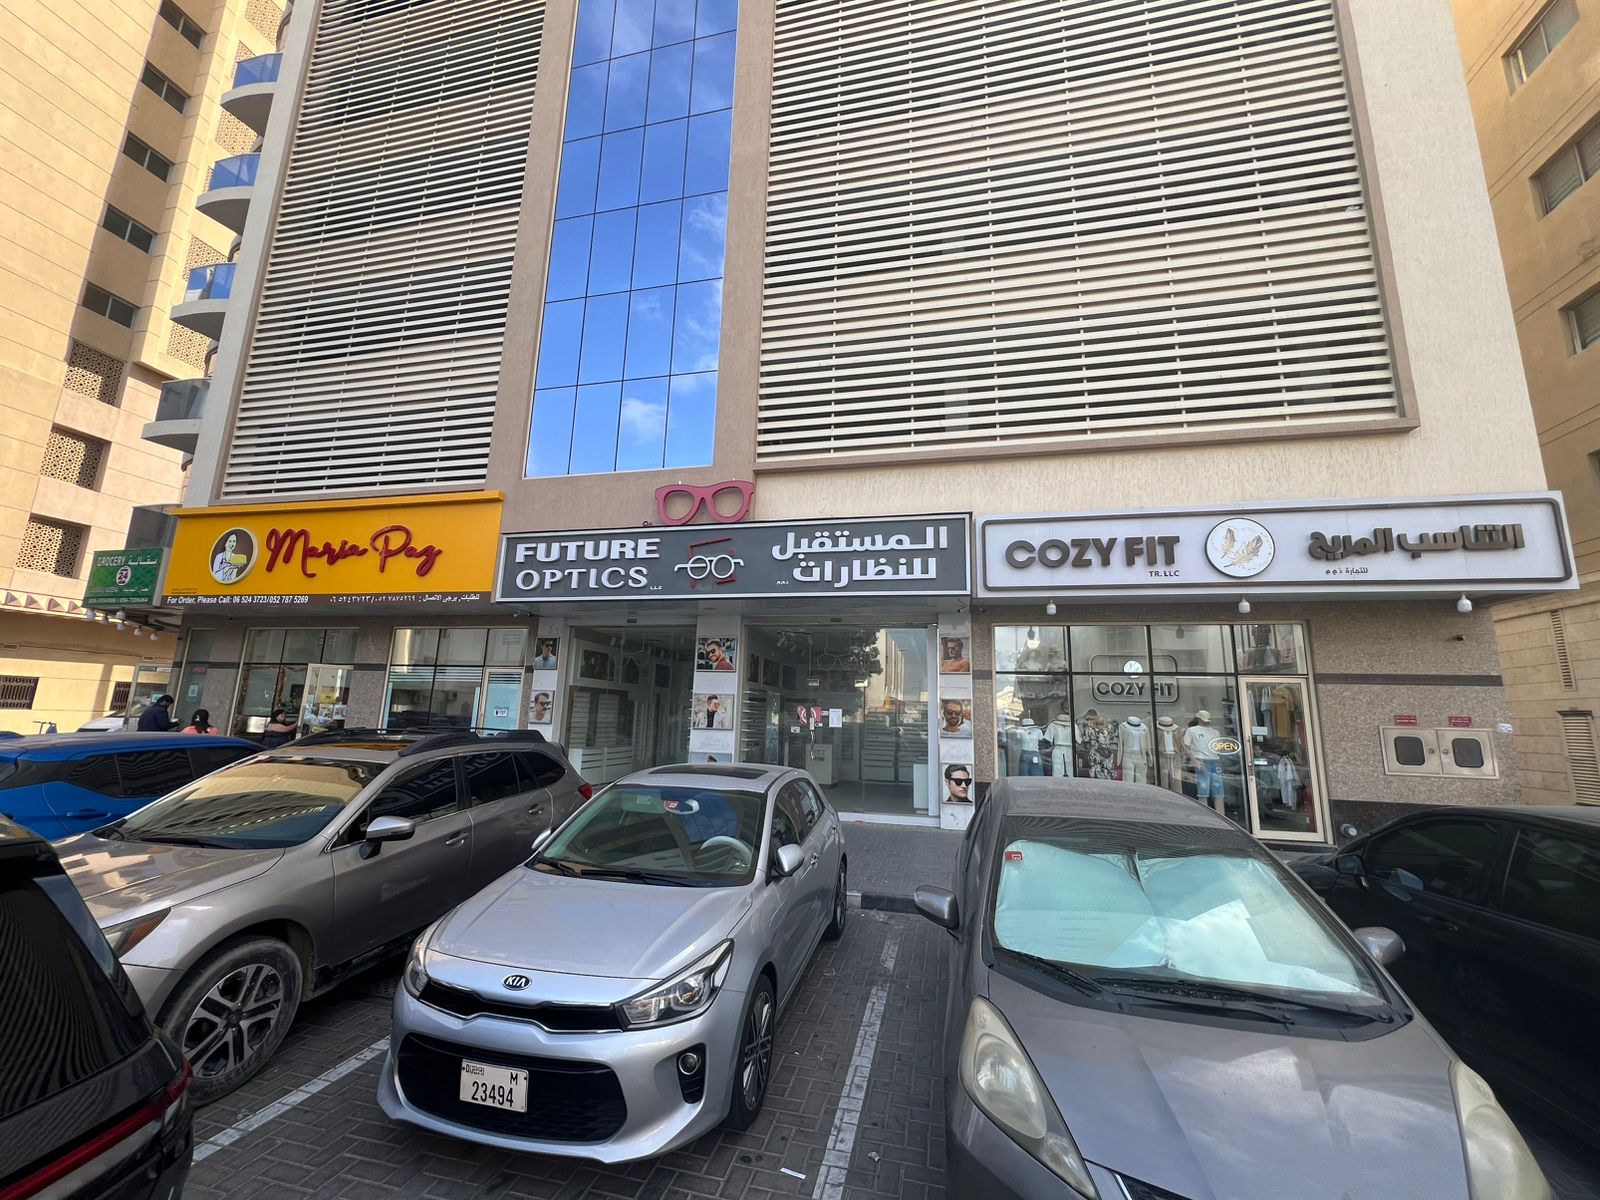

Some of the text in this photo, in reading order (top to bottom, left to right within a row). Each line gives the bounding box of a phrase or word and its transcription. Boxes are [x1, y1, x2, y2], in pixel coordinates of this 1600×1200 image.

[266, 525, 443, 578] Maria Paz
[515, 538, 661, 563] FUTURE
[772, 526, 948, 560] المستقبل
[1308, 524, 1525, 560] التناسب المريح
[97, 556, 126, 566] GROCERY
[1005, 536, 1181, 569] COZY FIT
[118, 571, 129, 581] 24
[515, 566, 648, 590] OPTICS
[792, 557, 937, 588] للنظارات
[1345, 567, 1369, 576] للتجارة
[166, 596, 177, 604] For
[178, 596, 196, 605] Order,
[197, 596, 217, 604] Please
[218, 595, 232, 604] Call:
[232, 595, 241, 603] 06
[241, 595, 252, 604] 524
[281, 595, 292, 603] 787
[293, 595, 309, 603] 5269
[1096, 681, 1146, 696] COZY
[1212, 742, 1238, 751] OPEN
[505, 976, 527, 988] KIA
[509, 1071, 519, 1086] M
[471, 1080, 514, 1107] 23494
